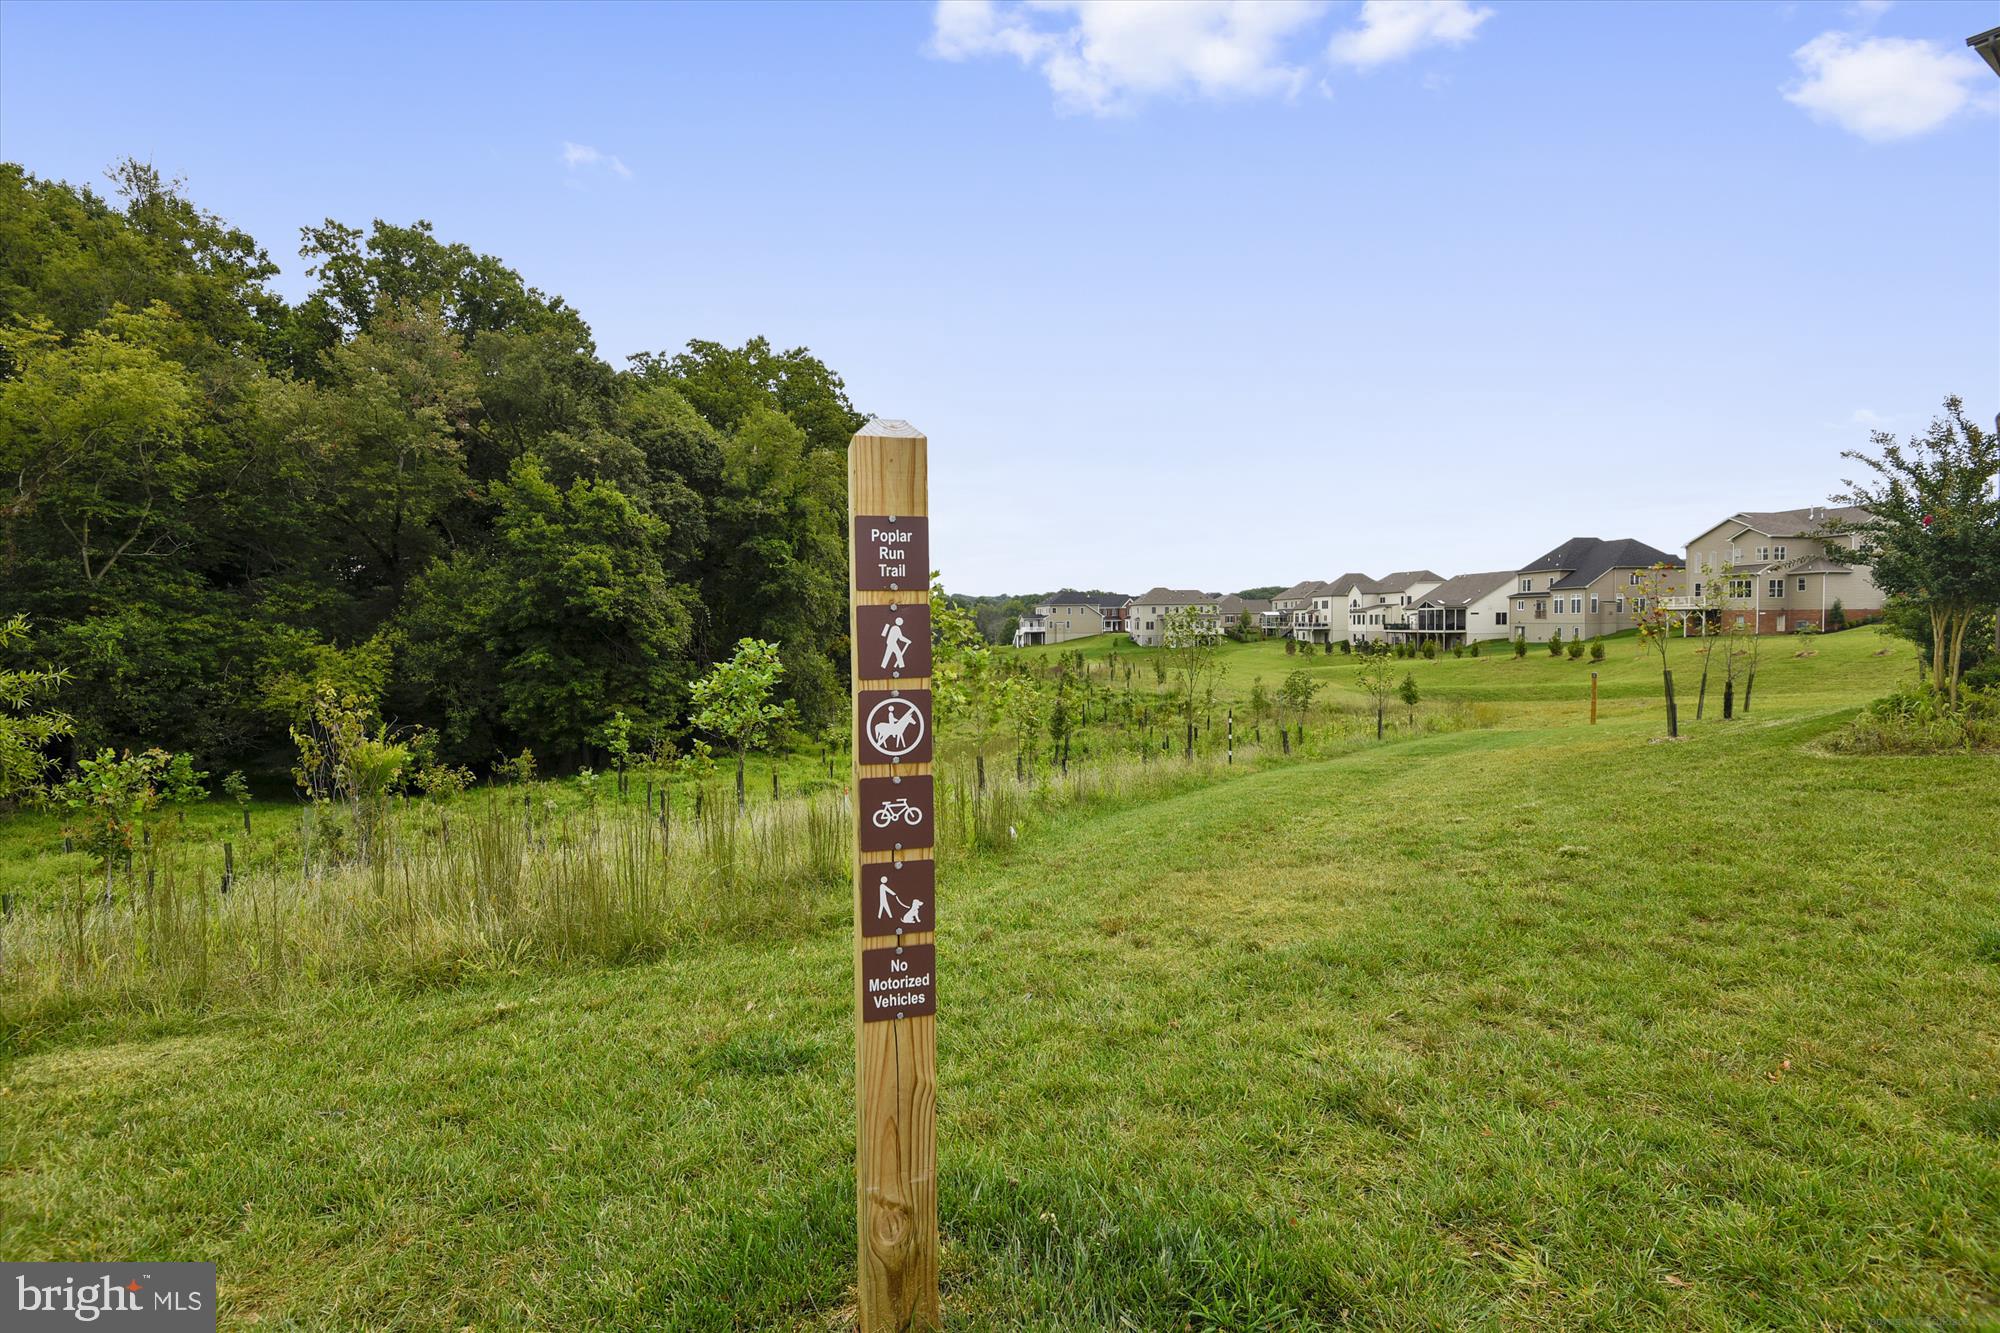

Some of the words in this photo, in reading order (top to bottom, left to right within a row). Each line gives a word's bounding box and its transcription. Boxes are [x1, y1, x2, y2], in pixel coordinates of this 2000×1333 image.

[871, 529, 912, 545] Poplar
[879, 546, 905, 560] Run
[878, 563, 906, 577] Trail
[890, 958, 908, 973] No
[869, 973, 930, 992] Motorized
[873, 992, 926, 1009] Vehicles
